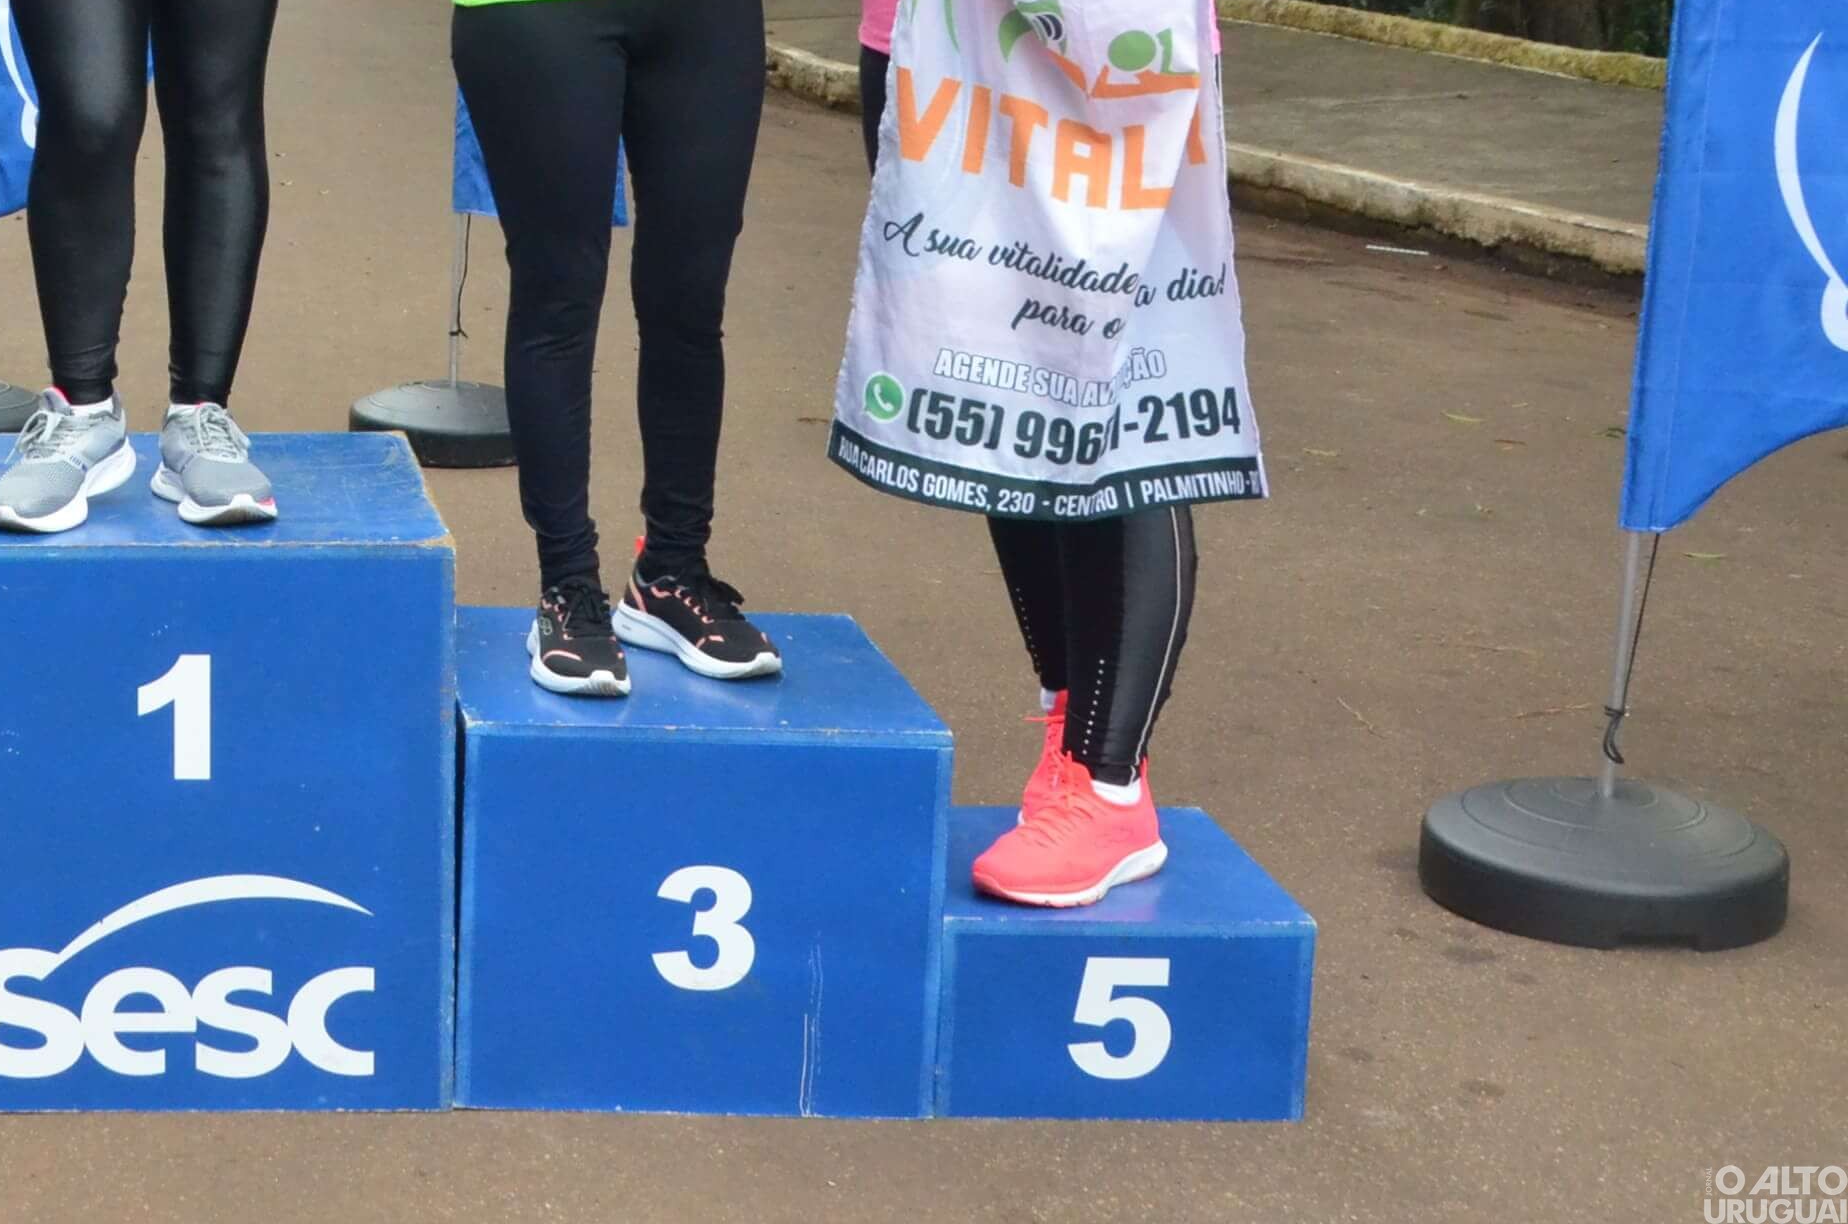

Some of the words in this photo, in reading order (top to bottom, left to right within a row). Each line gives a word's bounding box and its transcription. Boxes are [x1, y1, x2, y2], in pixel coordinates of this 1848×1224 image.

[883, 212, 924, 258] A
[923, 228, 983, 262] sua
[988, 241, 1139, 295] vitalidade
[1010, 297, 1095, 331] para
[1166, 262, 1227, 302] dia!
[933, 347, 1031, 393] AGENDE
[1032, 367, 1080, 408] SUA
[906, 387, 1005, 450] (55)
[859, 451, 920, 493] CARLOS
[922, 472, 991, 511] GOMES,
[996, 489, 1035, 515] 230
[1054, 485, 1119, 517] CENTRO
[137, 654, 211, 781] 1
[652, 866, 754, 992] 3
[1067, 957, 1172, 1081] 5
